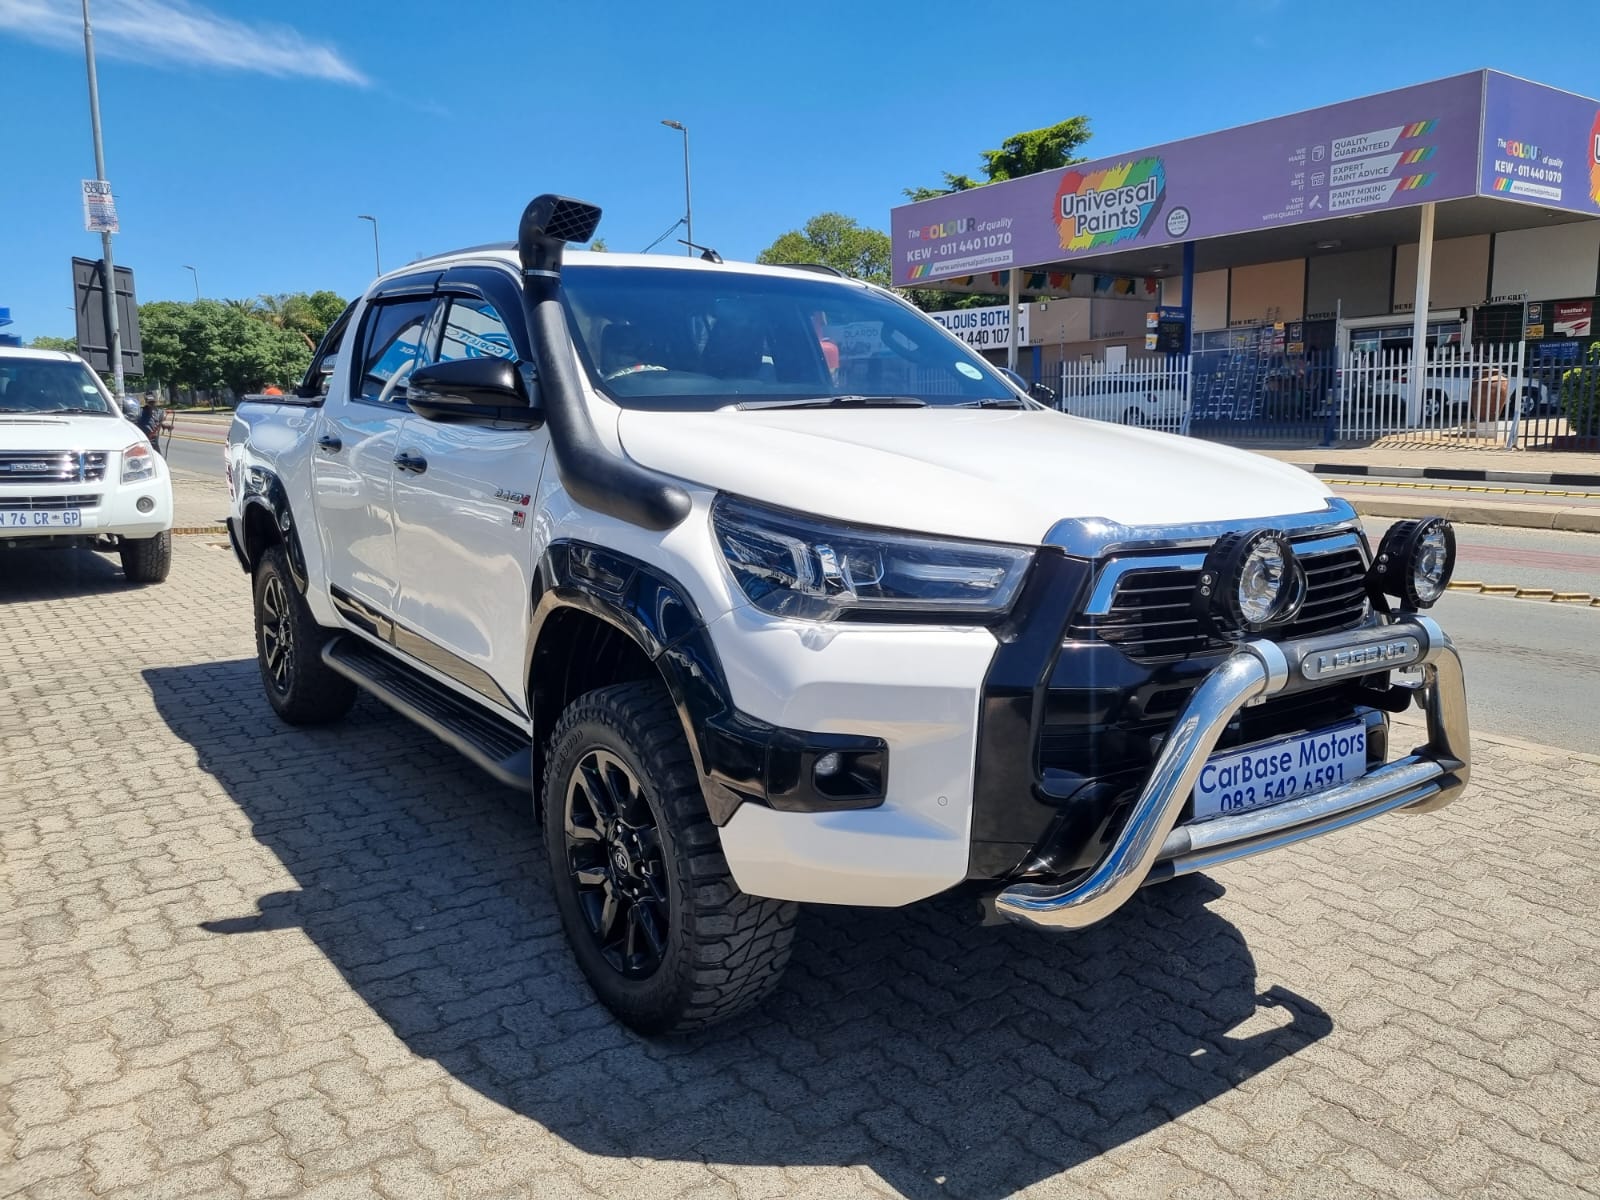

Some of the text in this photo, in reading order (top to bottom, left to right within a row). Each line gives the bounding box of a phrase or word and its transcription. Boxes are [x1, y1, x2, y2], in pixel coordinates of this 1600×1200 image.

[1334, 136, 1369, 150] QUALITY
[1334, 141, 1390, 157] GUARANTEED
[1506, 140, 1542, 160] COLOUR
[1332, 167, 1389, 183] PAINT ADVICE
[1333, 162, 1365, 175] EXPERT
[1495, 159, 1514, 174] KEW
[1518, 165, 1530, 177] 011
[1530, 167, 1544, 180] 440
[1545, 169, 1562, 183] 1070
[1062, 178, 1155, 216] Universal
[1332, 184, 1387, 199] PAINT MIXING
[1338, 194, 1381, 207] MATCHING
[908, 217, 1013, 240] The COLOUR of quality
[1077, 206, 1139, 234] Paints
[907, 247, 932, 262] KEW
[940, 242, 957, 256] 011
[959, 238, 981, 252] 440
[983, 232, 1012, 248] 1070
[934, 255, 1010, 272] www.universalpaints.co.za
[947, 310, 1010, 329] LOUIS BOTH
[967, 330, 989, 345] 440
[11, 513, 26, 525] 76
[34, 513, 49, 525] CR
[63, 512, 78, 524] GP
[1318, 642, 1408, 672] LEGEND
[1200, 733, 1364, 793] CarBase Motors
[1220, 763, 1344, 811] 083 542 6591
